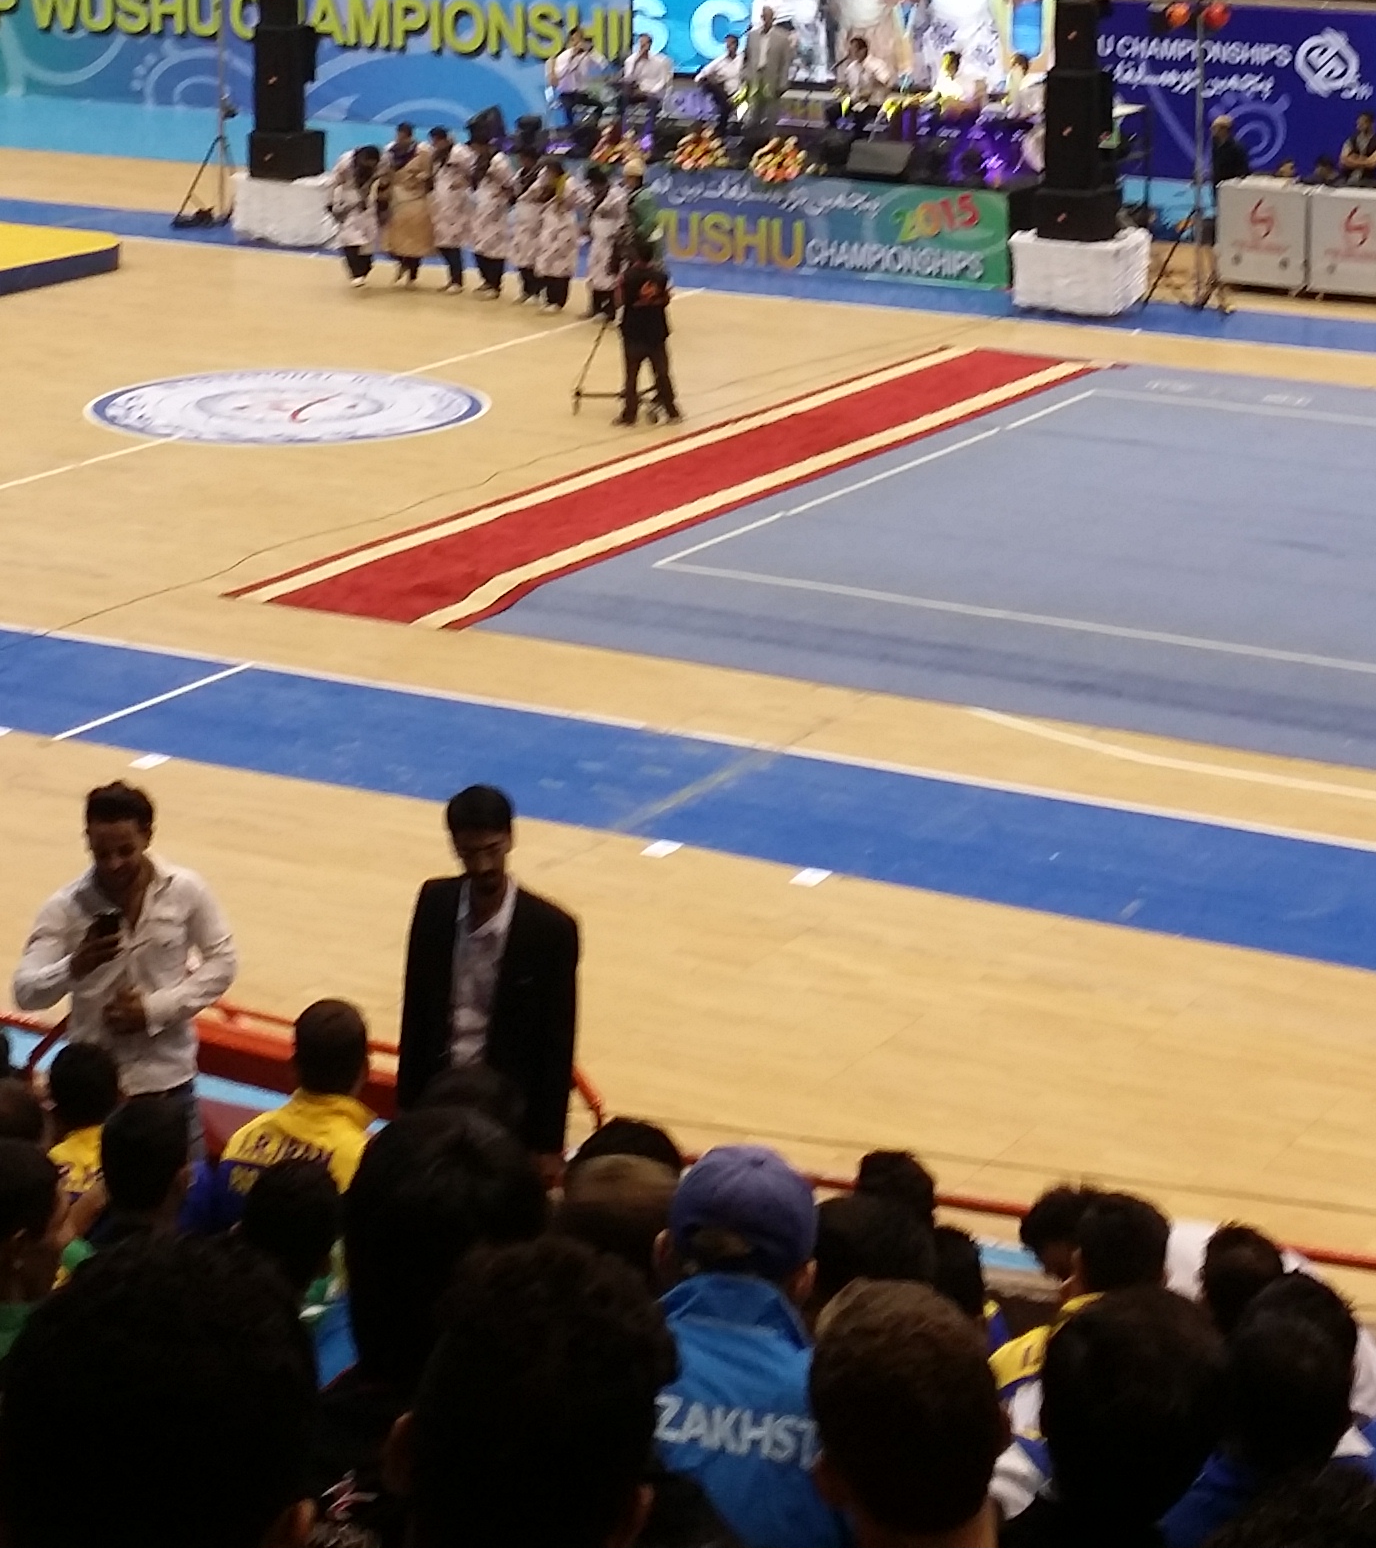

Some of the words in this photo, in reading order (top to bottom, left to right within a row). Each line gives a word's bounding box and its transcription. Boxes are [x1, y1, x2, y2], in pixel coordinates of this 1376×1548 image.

[890, 191, 981, 243] 2015
[806, 238, 985, 280] CHAMPIONSHIPS
[654, 1394, 824, 1472] ZAKHST
